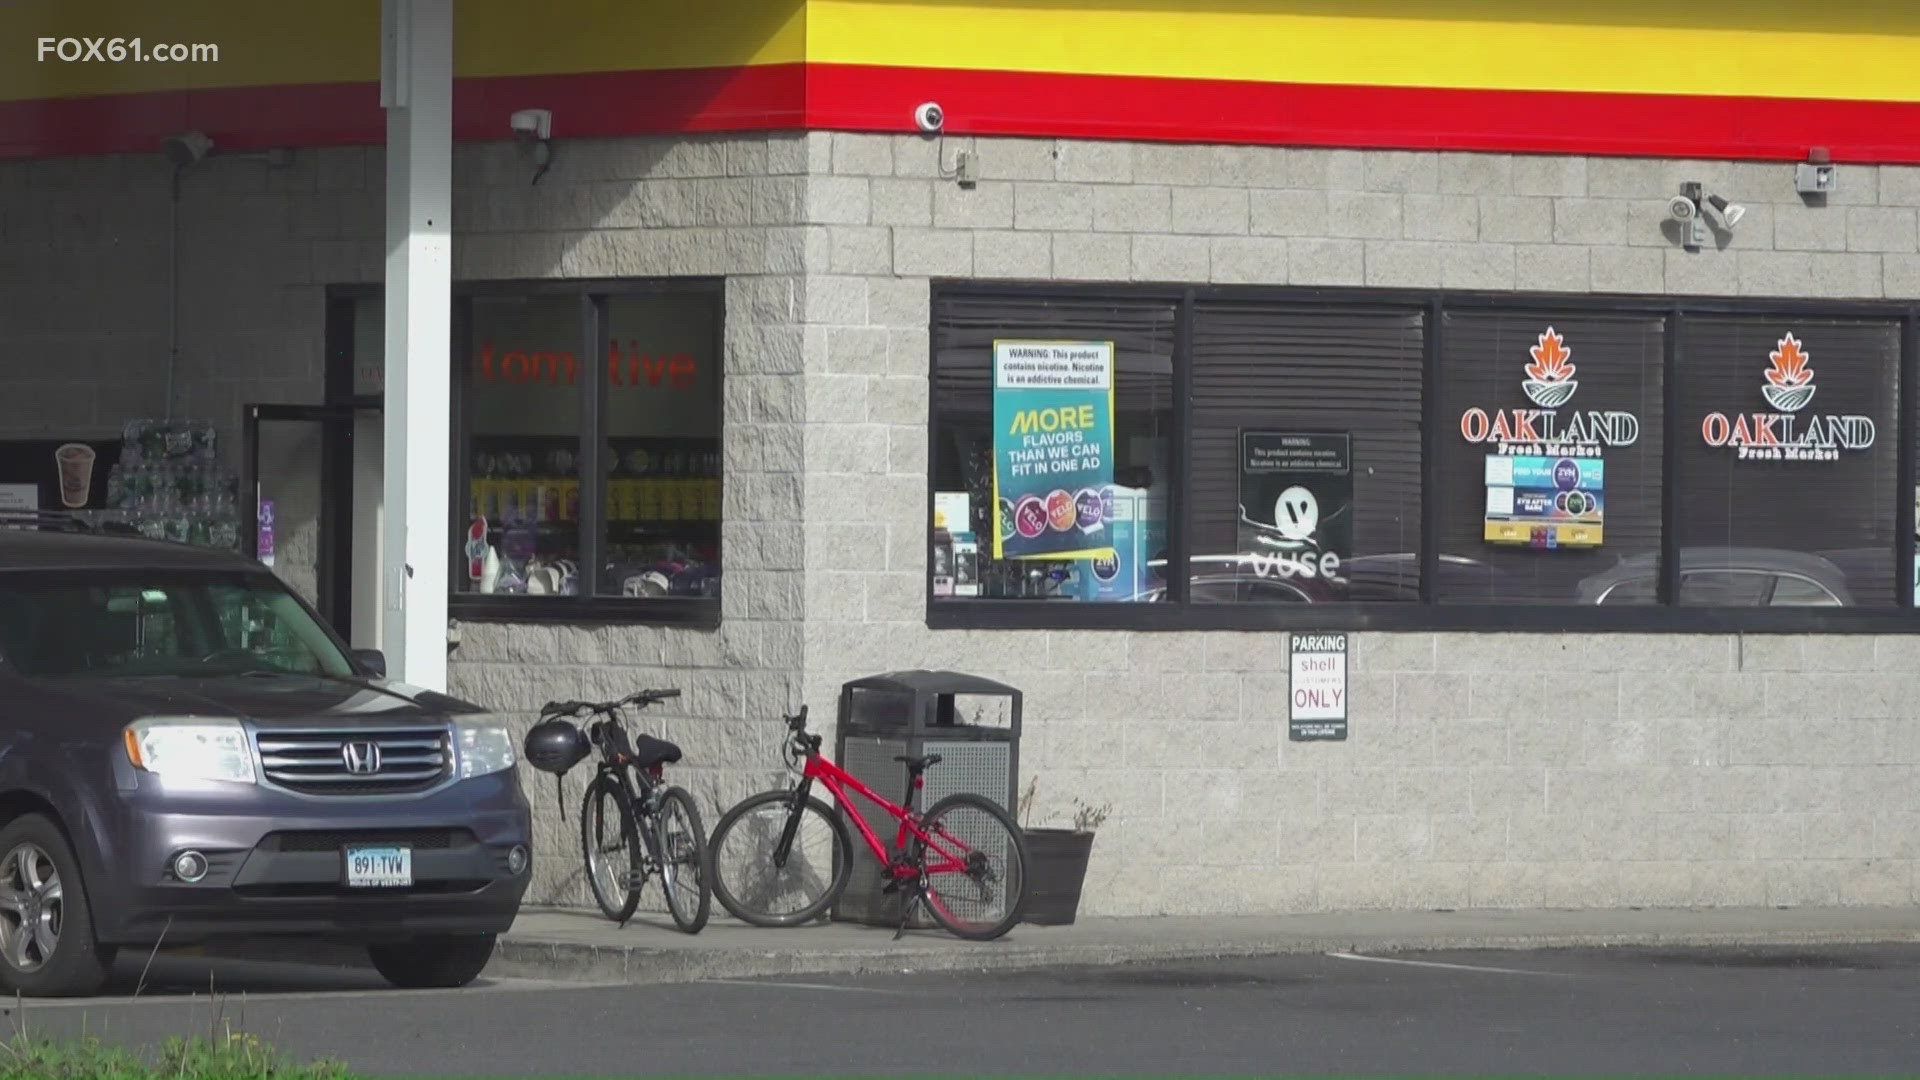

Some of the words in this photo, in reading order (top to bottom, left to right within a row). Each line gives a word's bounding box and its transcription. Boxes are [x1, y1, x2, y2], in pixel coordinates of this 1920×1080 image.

[1009, 348, 1050, 358] WARNING:
[1052, 349, 1068, 358] This
[1069, 350, 1099, 360] product
[1003, 362, 1036, 371] contains
[1037, 362, 1070, 371] nicotine.
[1072, 363, 1104, 372] Nicotine
[1007, 374, 1014, 383] is
[1026, 375, 1062, 384] addictive
[1063, 375, 1100, 384] chemical.
[1009, 404, 1094, 435] MORE
[1460, 407, 1639, 446] OAKLAND
[1702, 412, 1876, 449] OAKLAND
[1023, 431, 1083, 448] FLAVORS
[1008, 448, 1044, 463] THAN
[1047, 445, 1069, 459] WE
[1072, 443, 1100, 456] CAN
[1498, 442, 1543, 456] Fresh
[1545, 443, 1602, 457] Market
[1738, 446, 1782, 460] Fresh
[1785, 447, 1840, 461] Market
[1011, 463, 1032, 477] FIT
[1034, 462, 1048, 474] IN
[1051, 459, 1078, 472] ONE
[1081, 457, 1100, 470] AD
[1558, 467, 1576, 482] ZYN
[1051, 500, 1073, 518] VELO
[1077, 503, 1100, 517] VELO
[1023, 505, 1043, 531] VELO
[1250, 551, 1340, 578] vuse
[1292, 635, 1346, 652] PARKING
[1301, 657, 1335, 671] shell
[1294, 688, 1343, 708] ONLY
